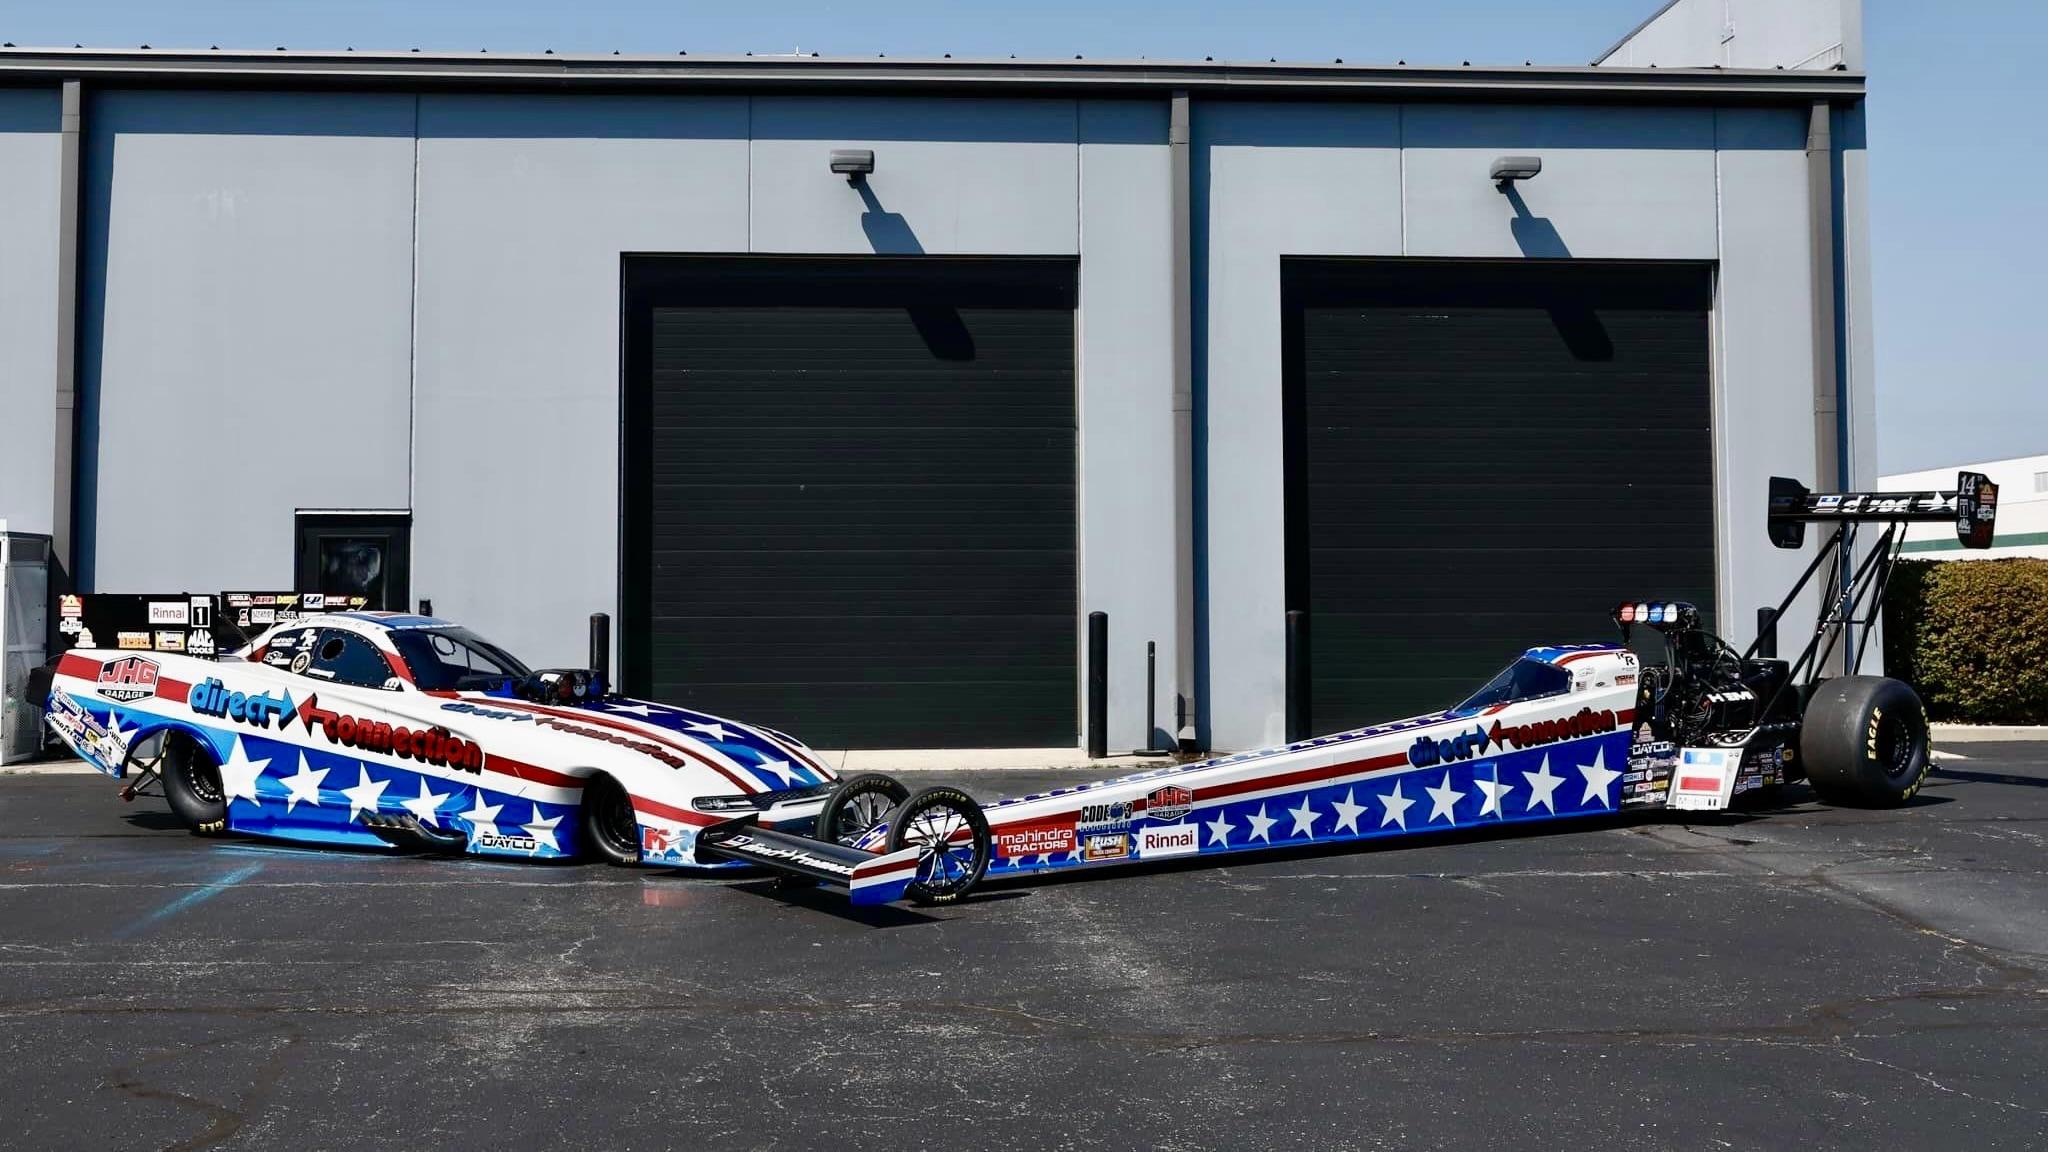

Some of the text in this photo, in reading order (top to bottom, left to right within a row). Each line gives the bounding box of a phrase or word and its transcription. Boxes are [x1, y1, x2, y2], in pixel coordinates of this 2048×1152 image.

[1959, 475, 1975, 495] 14
[152, 607, 185, 619] Rinnai
[196, 607, 204, 625] 1
[187, 629, 214, 647] MAC
[187, 646, 215, 655] TOOLS
[101, 659, 157, 685] JHG
[104, 689, 145, 700] GARAGE
[1707, 691, 1754, 702] HEMI
[46, 712, 82, 743] GOODYEAR
[190, 677, 484, 776] direct connection
[1867, 706, 1882, 760] EAGLE
[110, 731, 127, 750] WELD
[1408, 707, 1617, 768] direct connection
[1632, 741, 1671, 756] DAYCO
[1147, 787, 1190, 808] JHG
[1081, 802, 1134, 823] CODE 3
[482, 834, 536, 850] DAYCO
[1001, 828, 1073, 846] mahindra
[1006, 839, 1068, 853] TRACTORS
[1145, 830, 1194, 850] Rinnai
